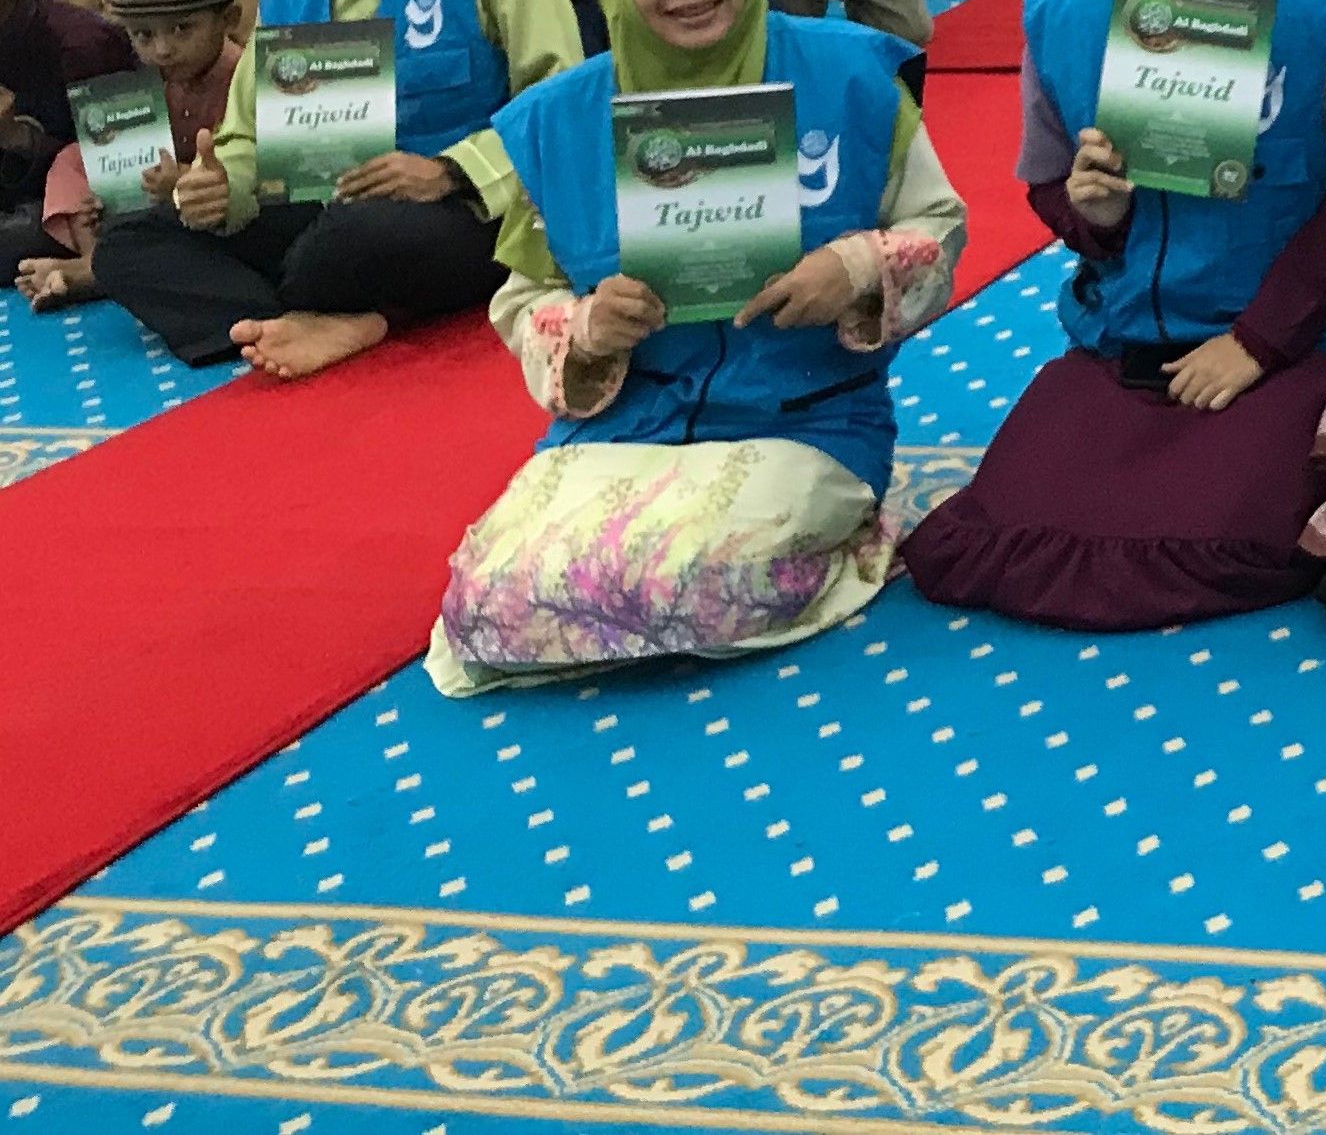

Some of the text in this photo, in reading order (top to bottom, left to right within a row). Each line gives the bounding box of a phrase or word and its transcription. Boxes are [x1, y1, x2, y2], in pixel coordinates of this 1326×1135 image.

[1135, 66, 1236, 101] Tajwid
[285, 101, 370, 129] Tajwid
[99, 147, 155, 174] Tajwid
[685, 141, 768, 156] Al Baghdadi
[655, 195, 766, 232] Tajwid
